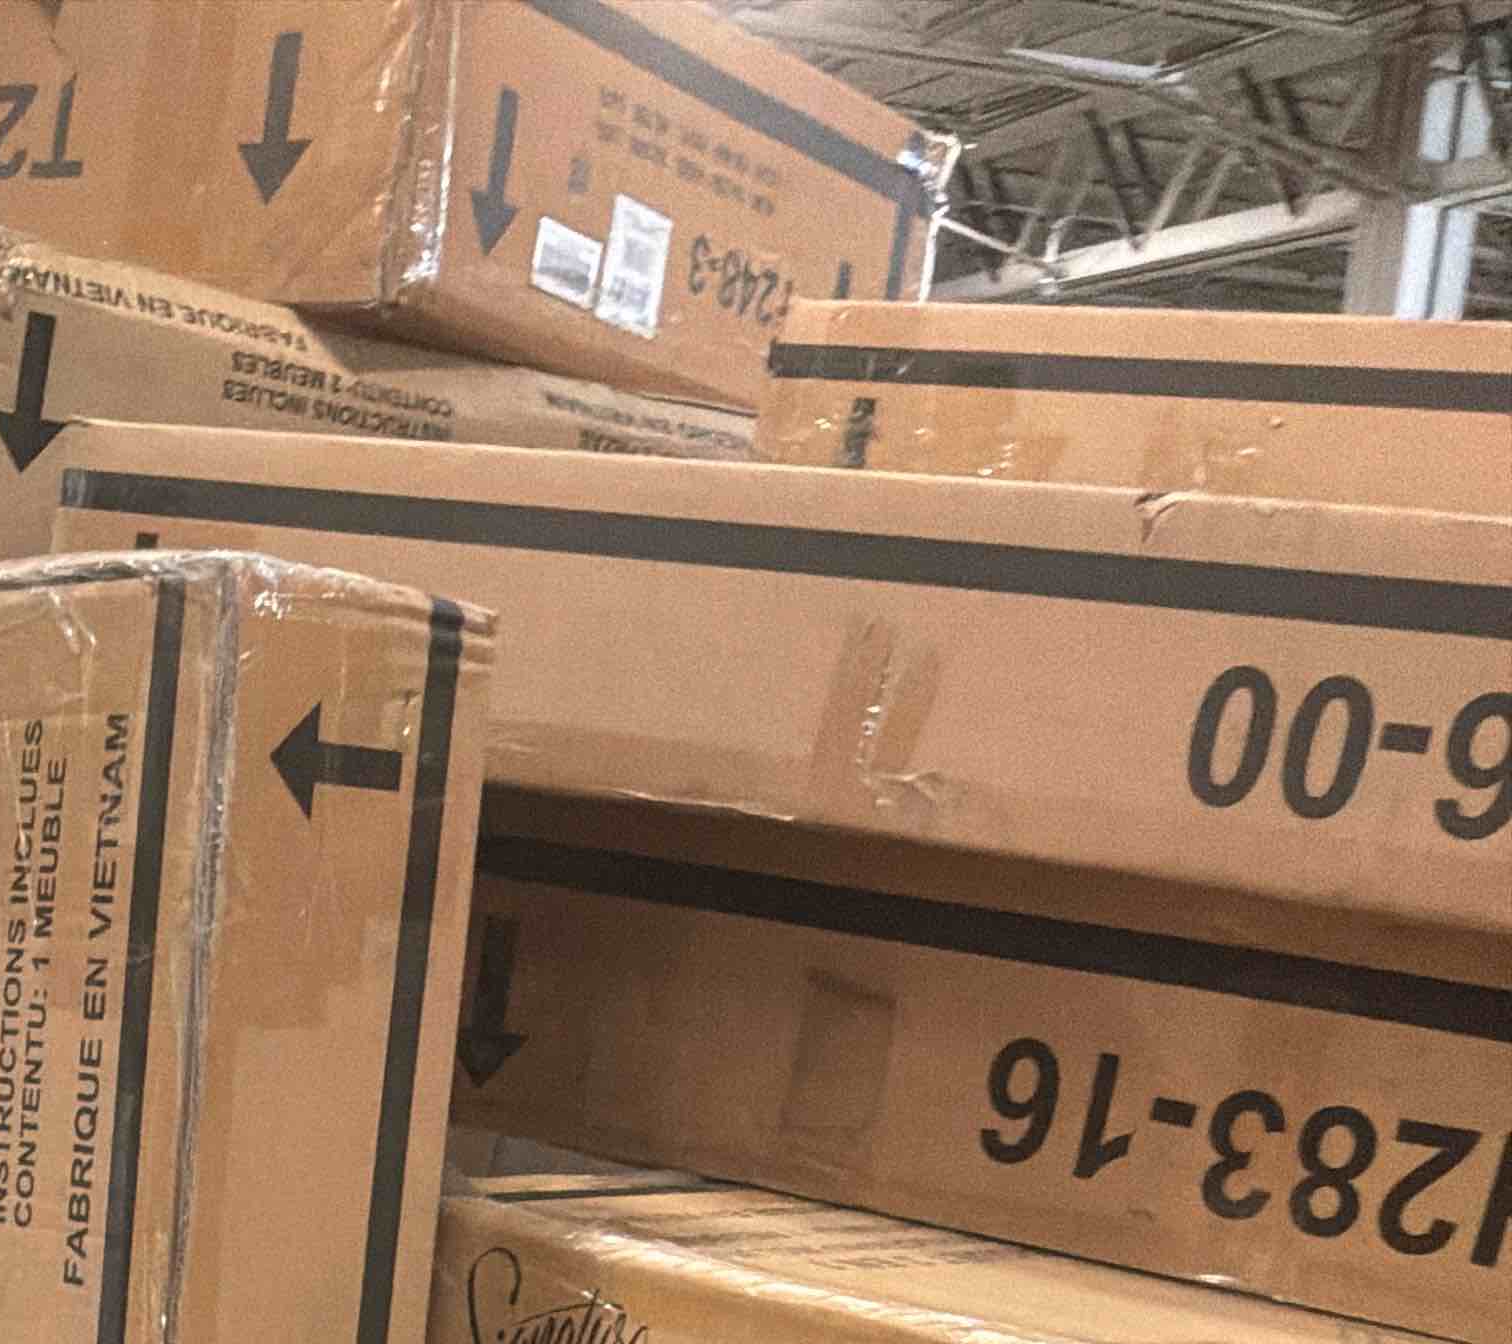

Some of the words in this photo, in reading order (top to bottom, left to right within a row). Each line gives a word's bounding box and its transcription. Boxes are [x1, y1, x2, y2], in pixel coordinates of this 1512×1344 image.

[137, 293, 174, 320] EN
[231, 352, 327, 391] MEUBLES
[222, 379, 308, 417] INCLUES
[8, 719, 44, 905] INCLUES
[33, 757, 67, 938] MEUBLE
[88, 712, 130, 940] VIETNAM
[32, 955, 53, 969] 1
[82, 956, 109, 1019] EN
[15, 988, 49, 1228] CONTENTU:
[63, 1037, 102, 1287] FABRIQUE
[981, 1038, 1512, 1267] 283-16
